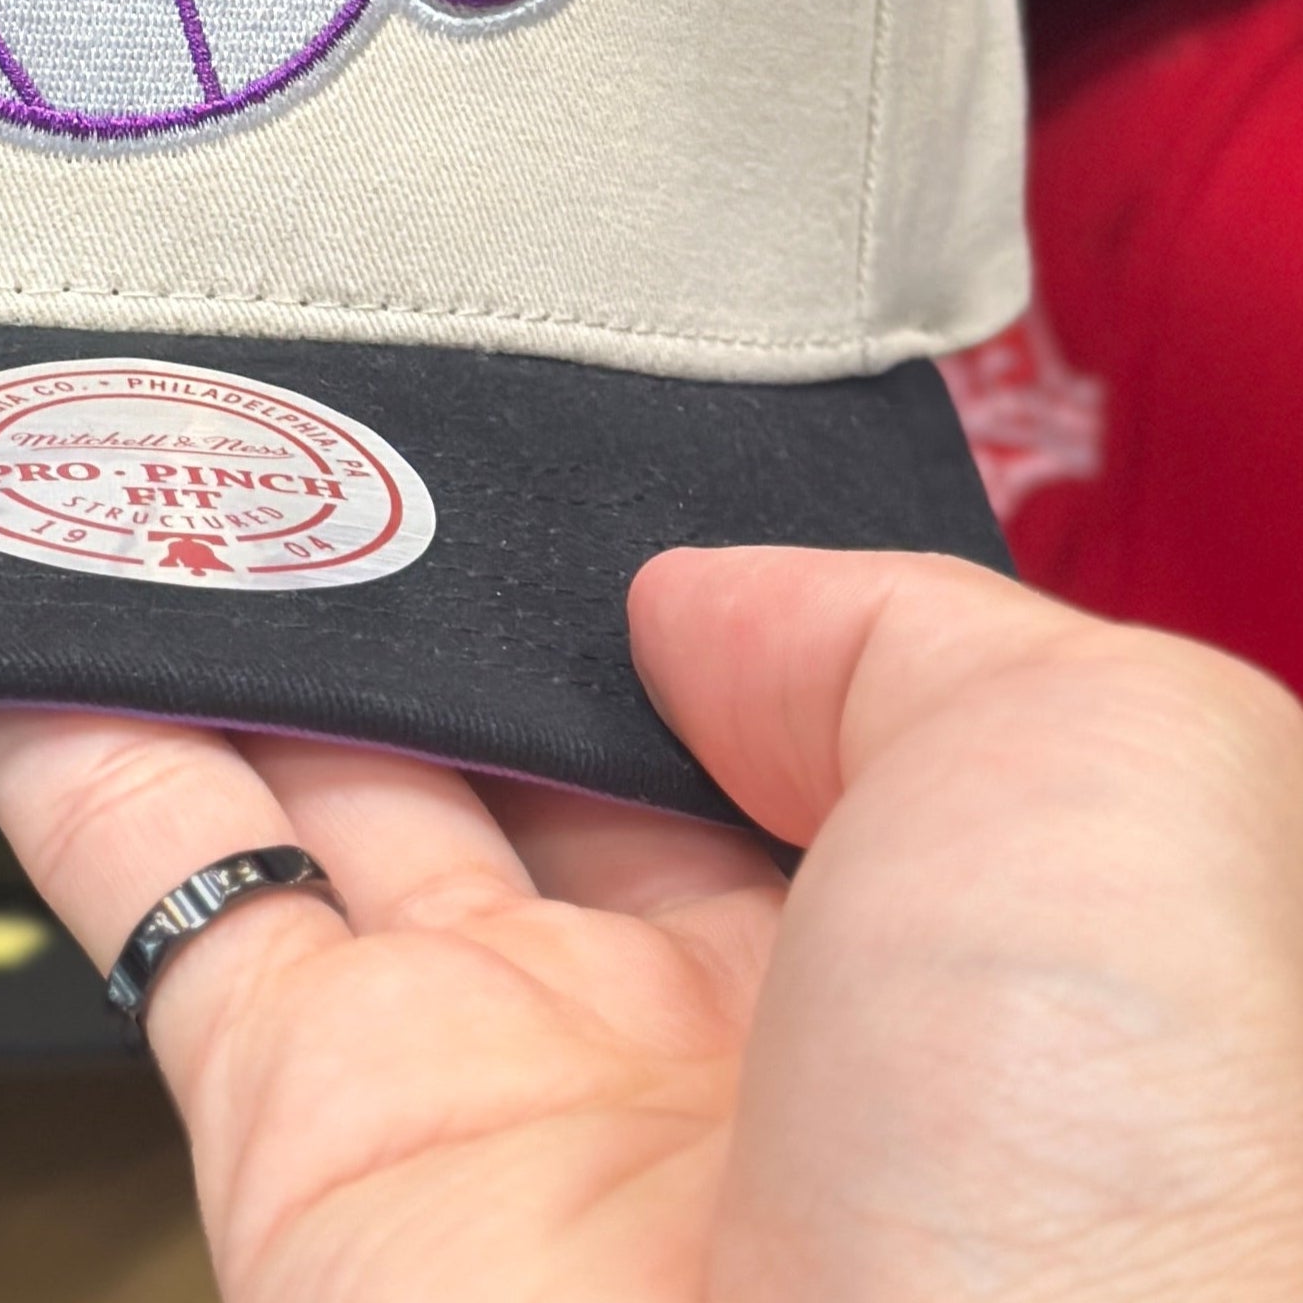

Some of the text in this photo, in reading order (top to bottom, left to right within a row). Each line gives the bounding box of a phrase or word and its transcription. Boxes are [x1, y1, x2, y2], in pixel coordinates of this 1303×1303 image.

[11, 431, 292, 456] Mitchell & Ness
[32, 381, 89, 397] CO.
[127, 377, 338, 452] PHILADELPHIA,
[336, 458, 371, 479] PA
[122, 486, 223, 510] FIT
[140, 463, 348, 501] PINCH
[62, 496, 284, 530] STRUCTURED
